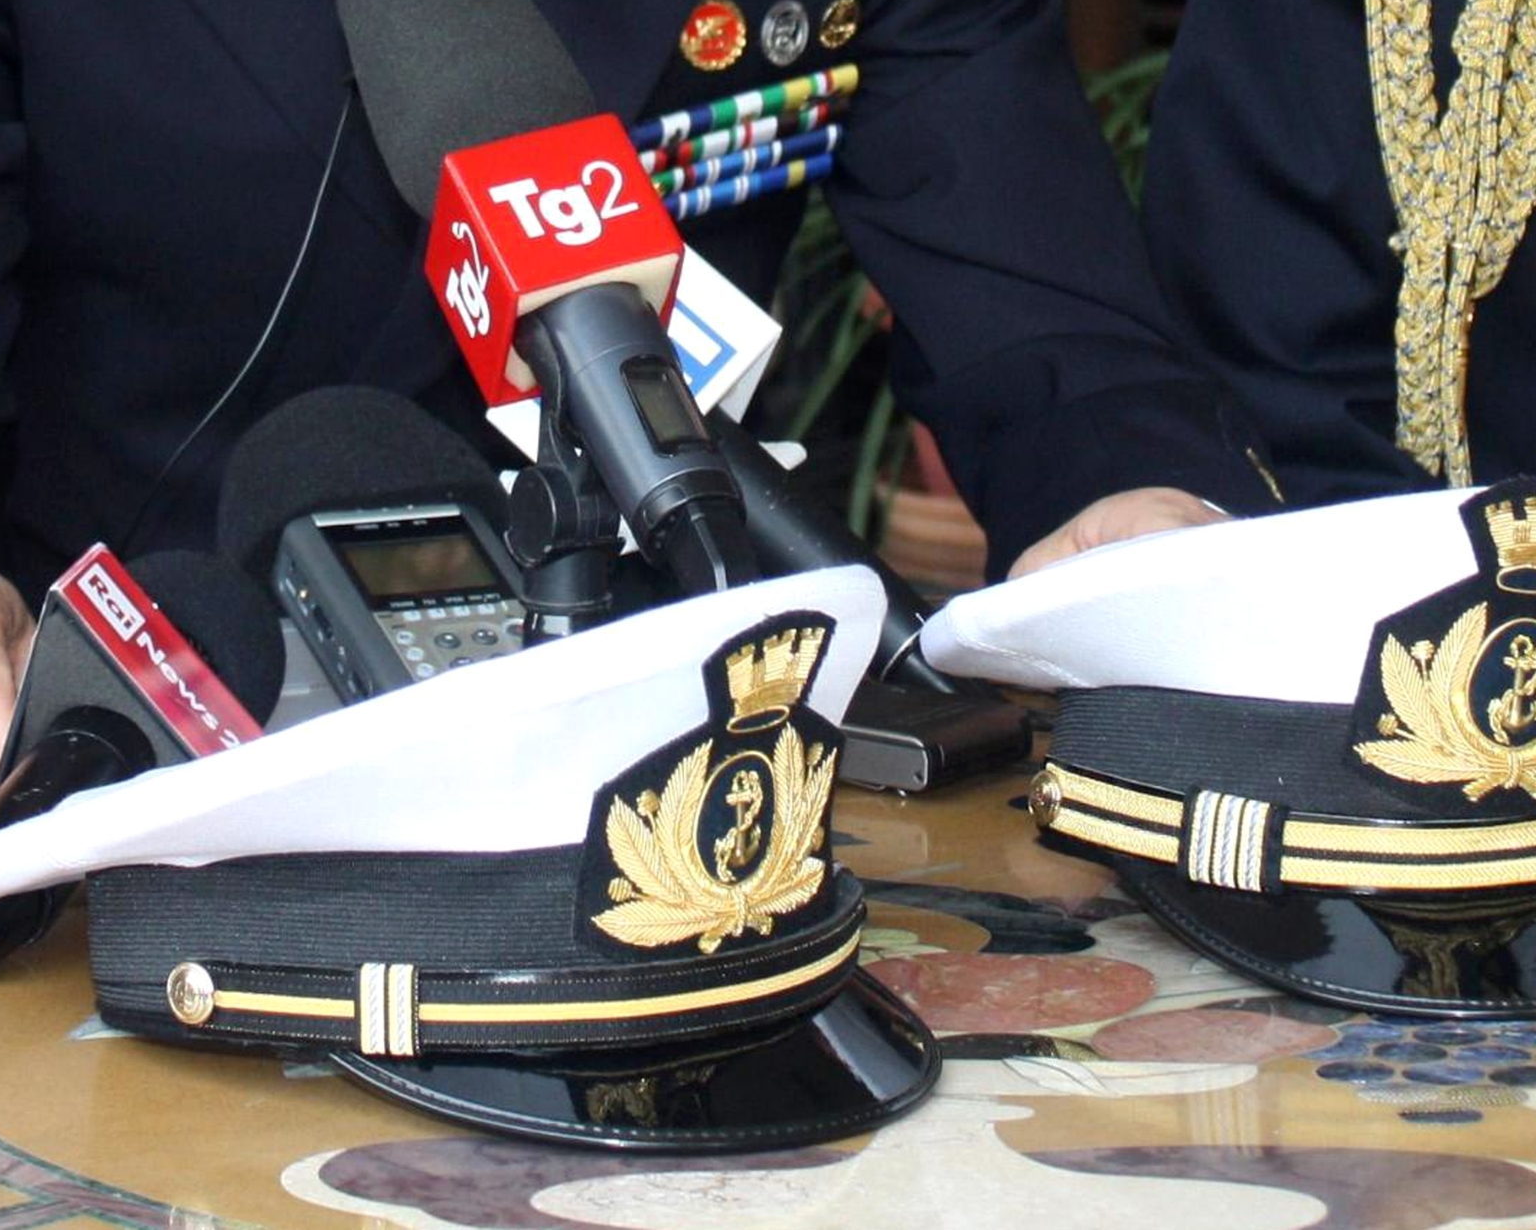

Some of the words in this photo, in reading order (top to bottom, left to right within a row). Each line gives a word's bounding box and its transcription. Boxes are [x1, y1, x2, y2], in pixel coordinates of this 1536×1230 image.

[488, 160, 639, 246] Tg2
[445, 221, 490, 339] Tg2
[88, 574, 135, 630] Rai
[136, 631, 219, 730] News
